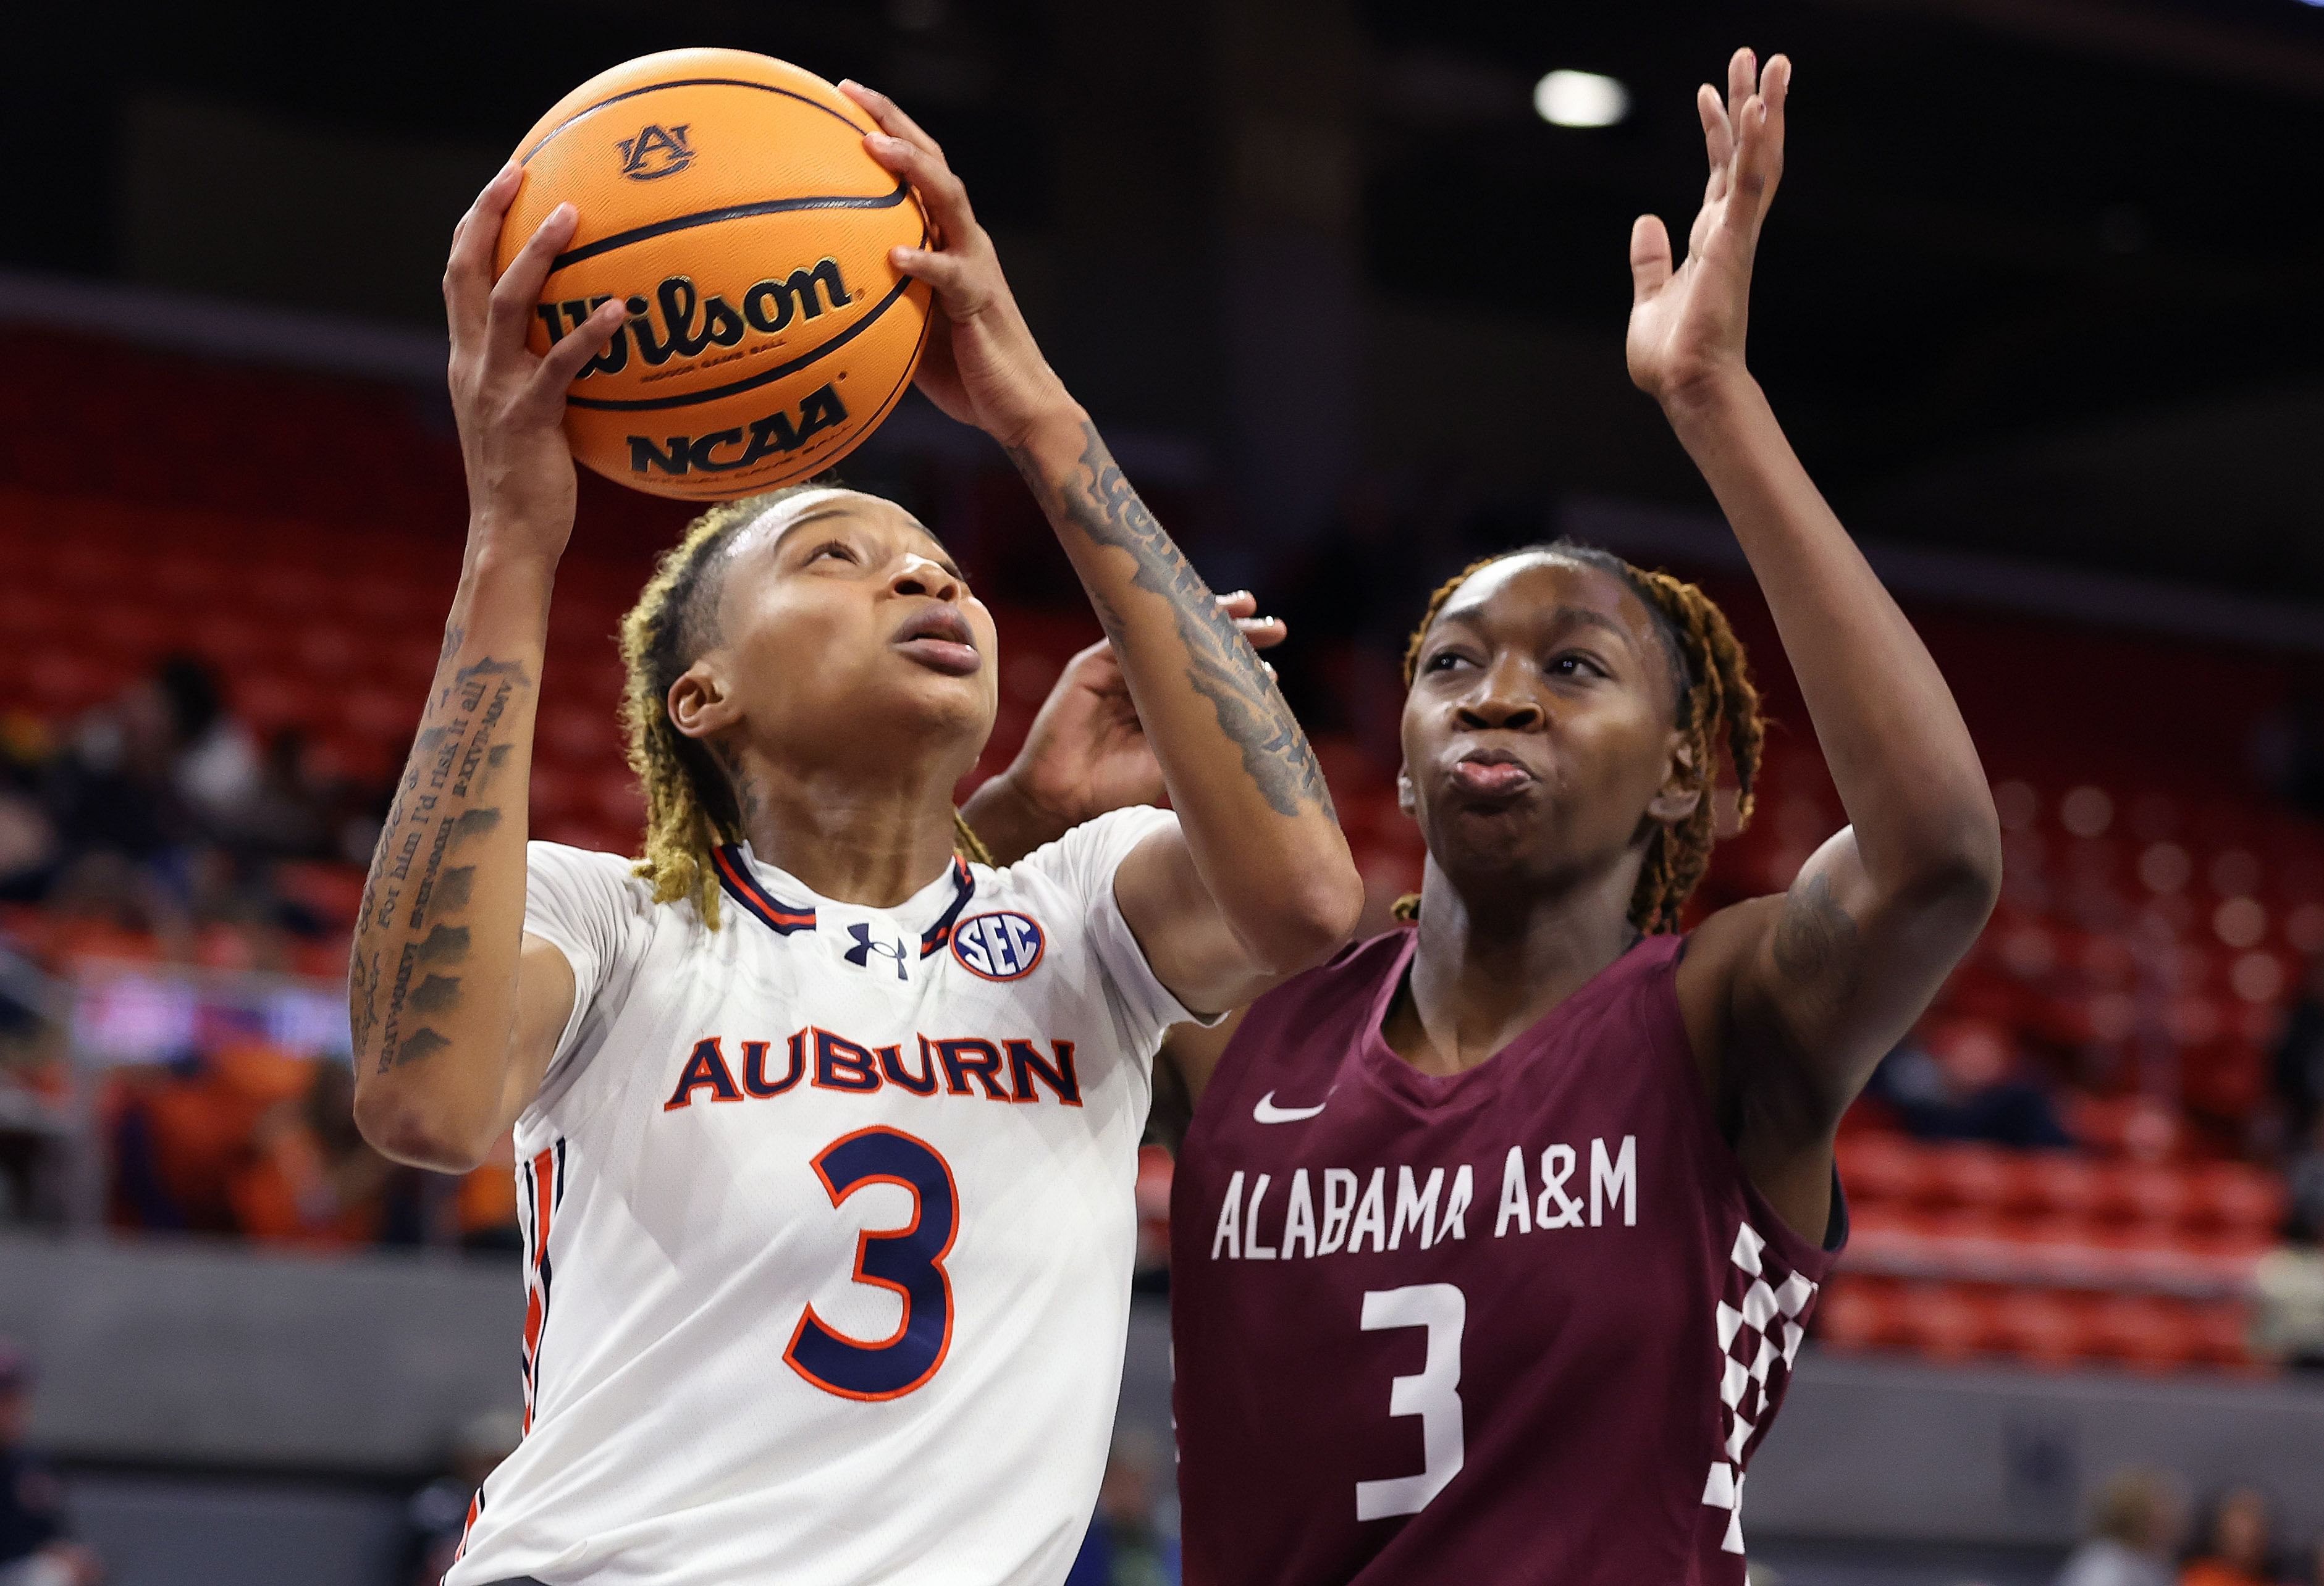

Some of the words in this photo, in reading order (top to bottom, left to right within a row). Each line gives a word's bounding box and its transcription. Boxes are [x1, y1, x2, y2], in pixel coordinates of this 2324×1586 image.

[537, 256, 852, 380] Wilson
[626, 383, 849, 476] NCAA
[461, 682, 487, 711] all
[955, 913, 1039, 976] SEC
[664, 1025, 1084, 1111] AUBURN
[1211, 1164, 1473, 1260] ALABAMA
[1494, 1135, 1636, 1238] A&M
[782, 1125, 959, 1403] 3
[1356, 1282, 1466, 1522] 3
